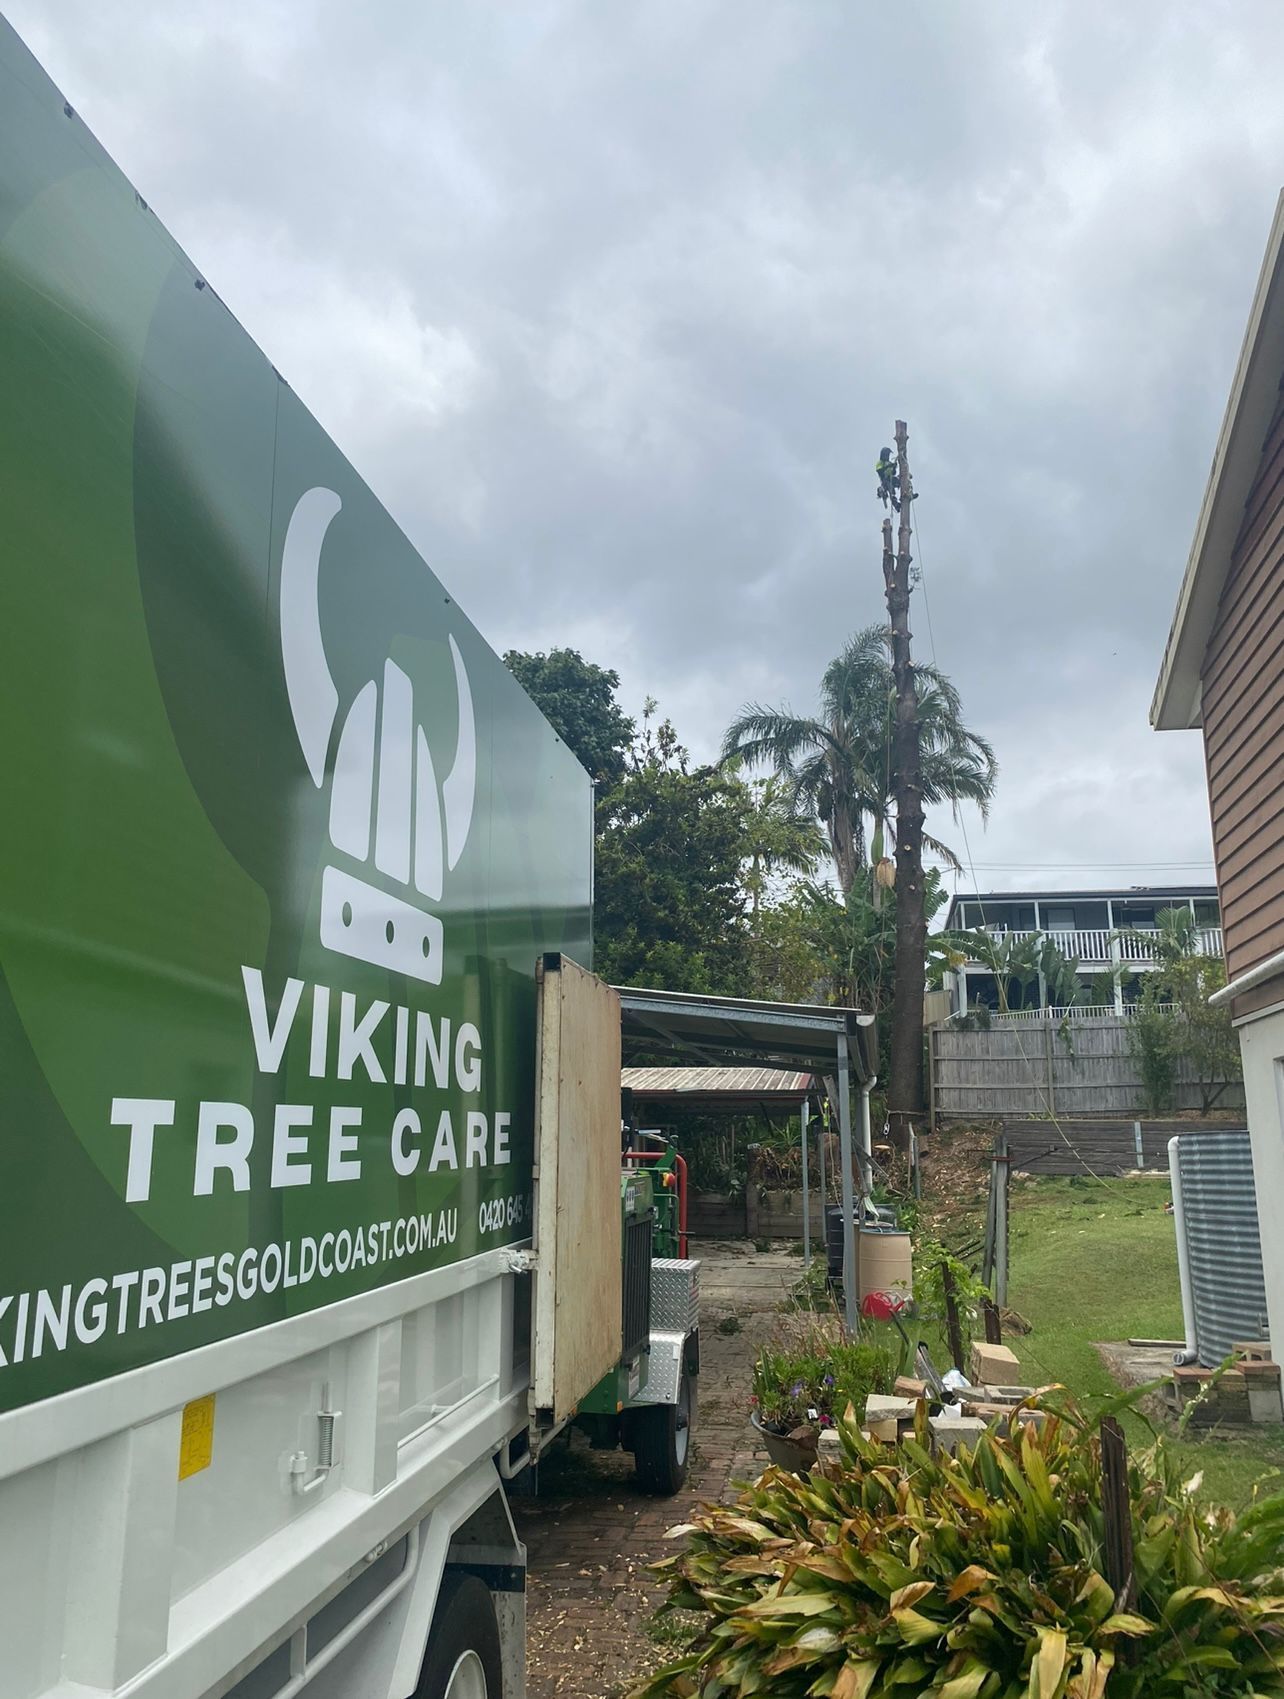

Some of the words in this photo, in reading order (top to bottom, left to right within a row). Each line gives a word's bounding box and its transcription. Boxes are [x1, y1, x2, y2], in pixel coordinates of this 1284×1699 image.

[241, 965, 482, 1092] VIKING
[110, 1097, 363, 1203] TREE
[391, 1107, 511, 1177] CARE
[479, 1198, 505, 1234] 0420
